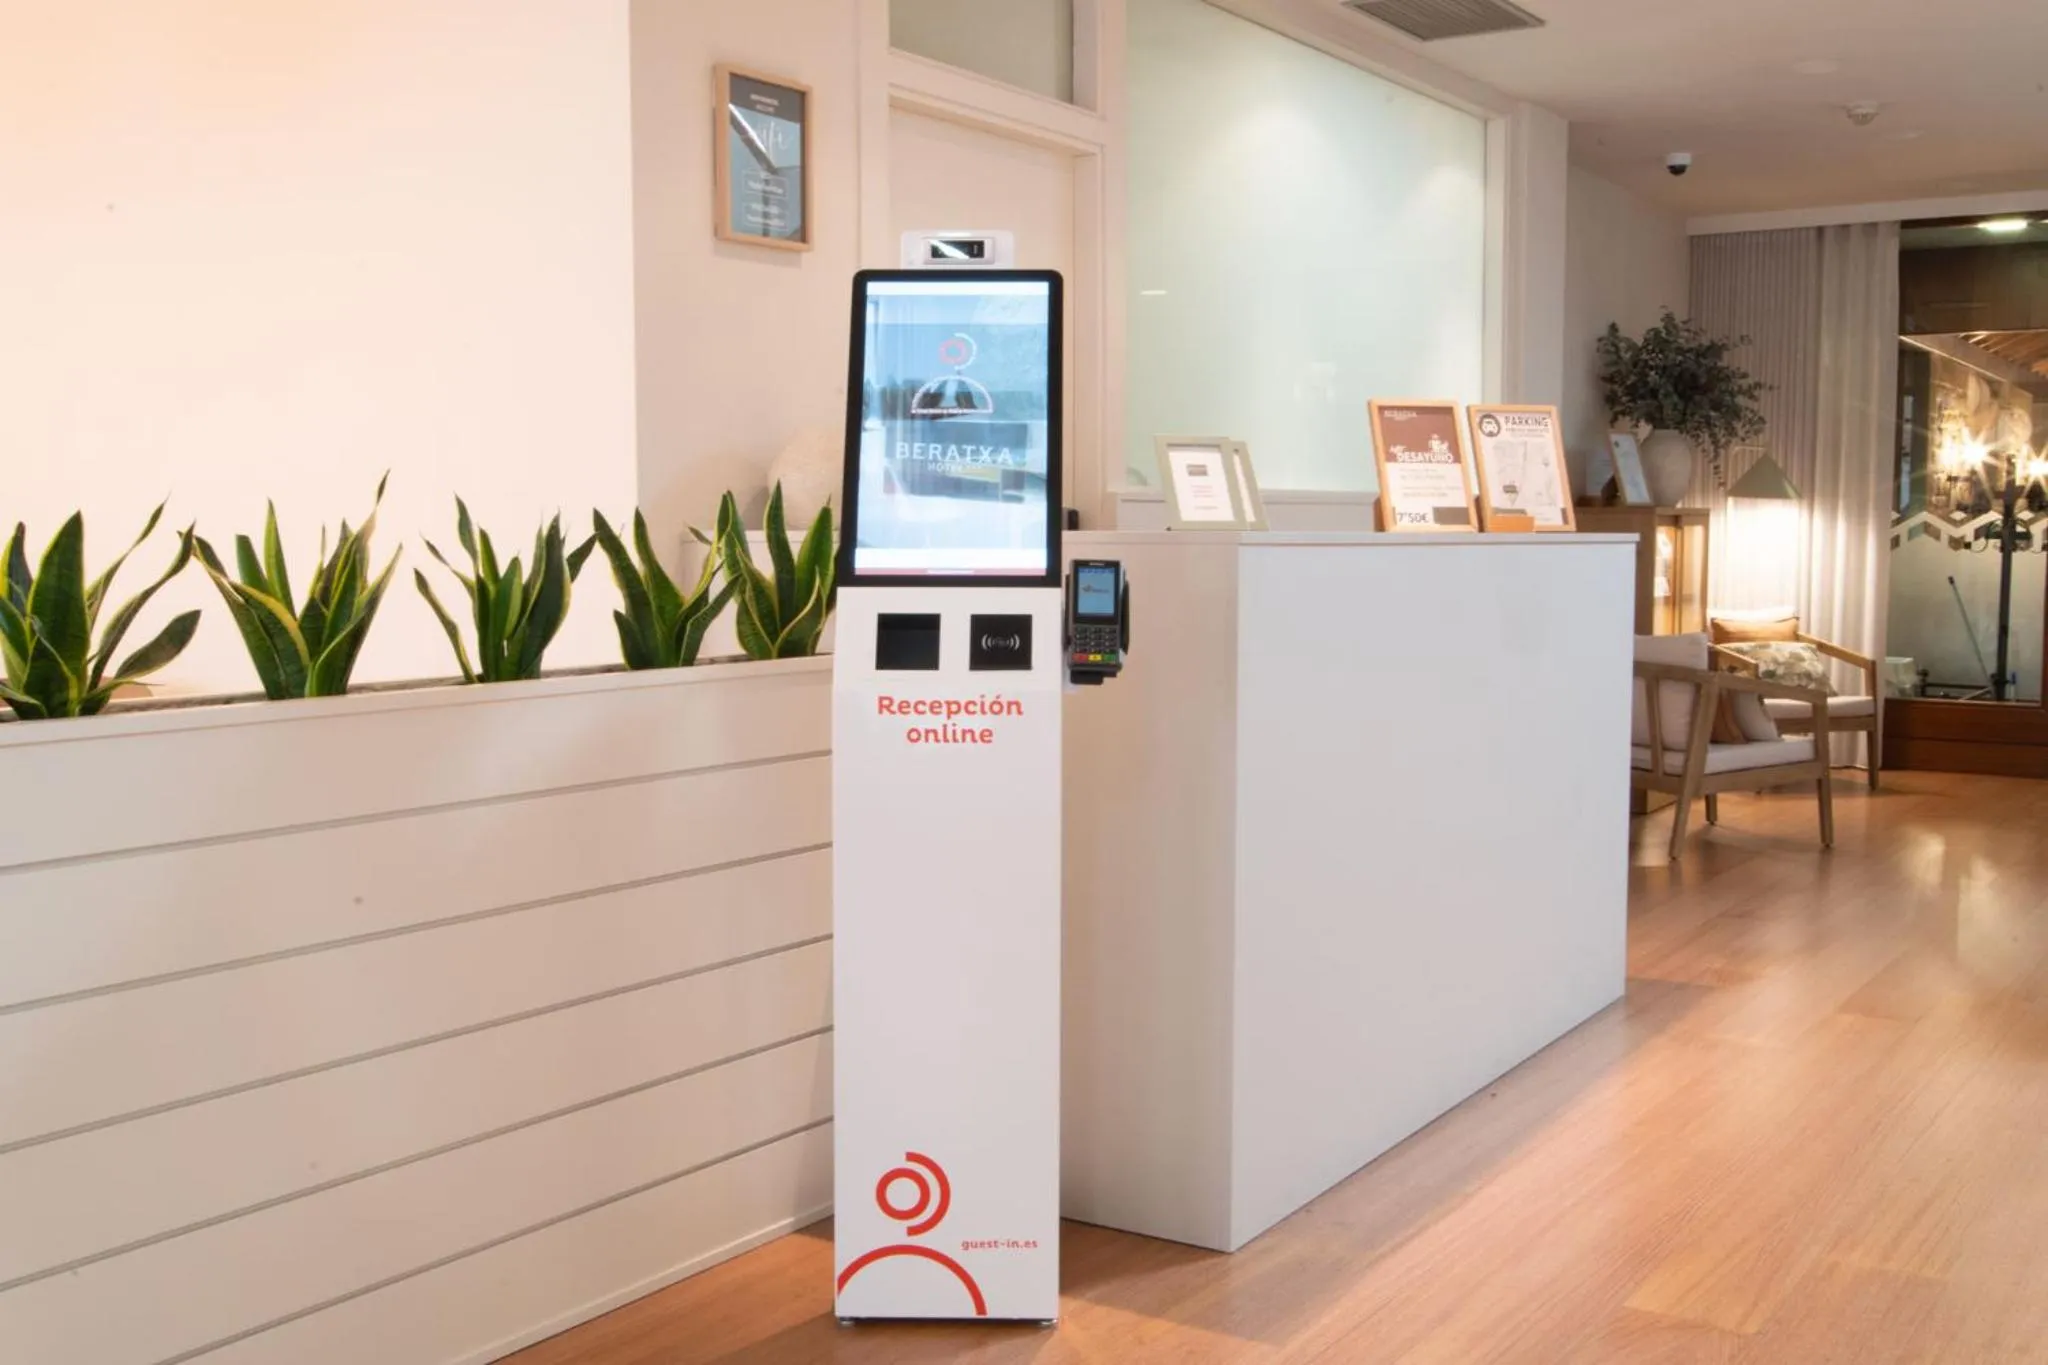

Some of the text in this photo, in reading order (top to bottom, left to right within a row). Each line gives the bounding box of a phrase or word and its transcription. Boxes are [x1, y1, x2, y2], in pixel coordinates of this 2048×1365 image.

[1504, 415, 1549, 428] PARKING
[895, 441, 1014, 466] BERATXA
[1396, 451, 1454, 464] DESAYUNO
[877, 694, 1024, 719] Recepción
[906, 723, 994, 744] online
[961, 1239, 1038, 1251] guest-in.es
